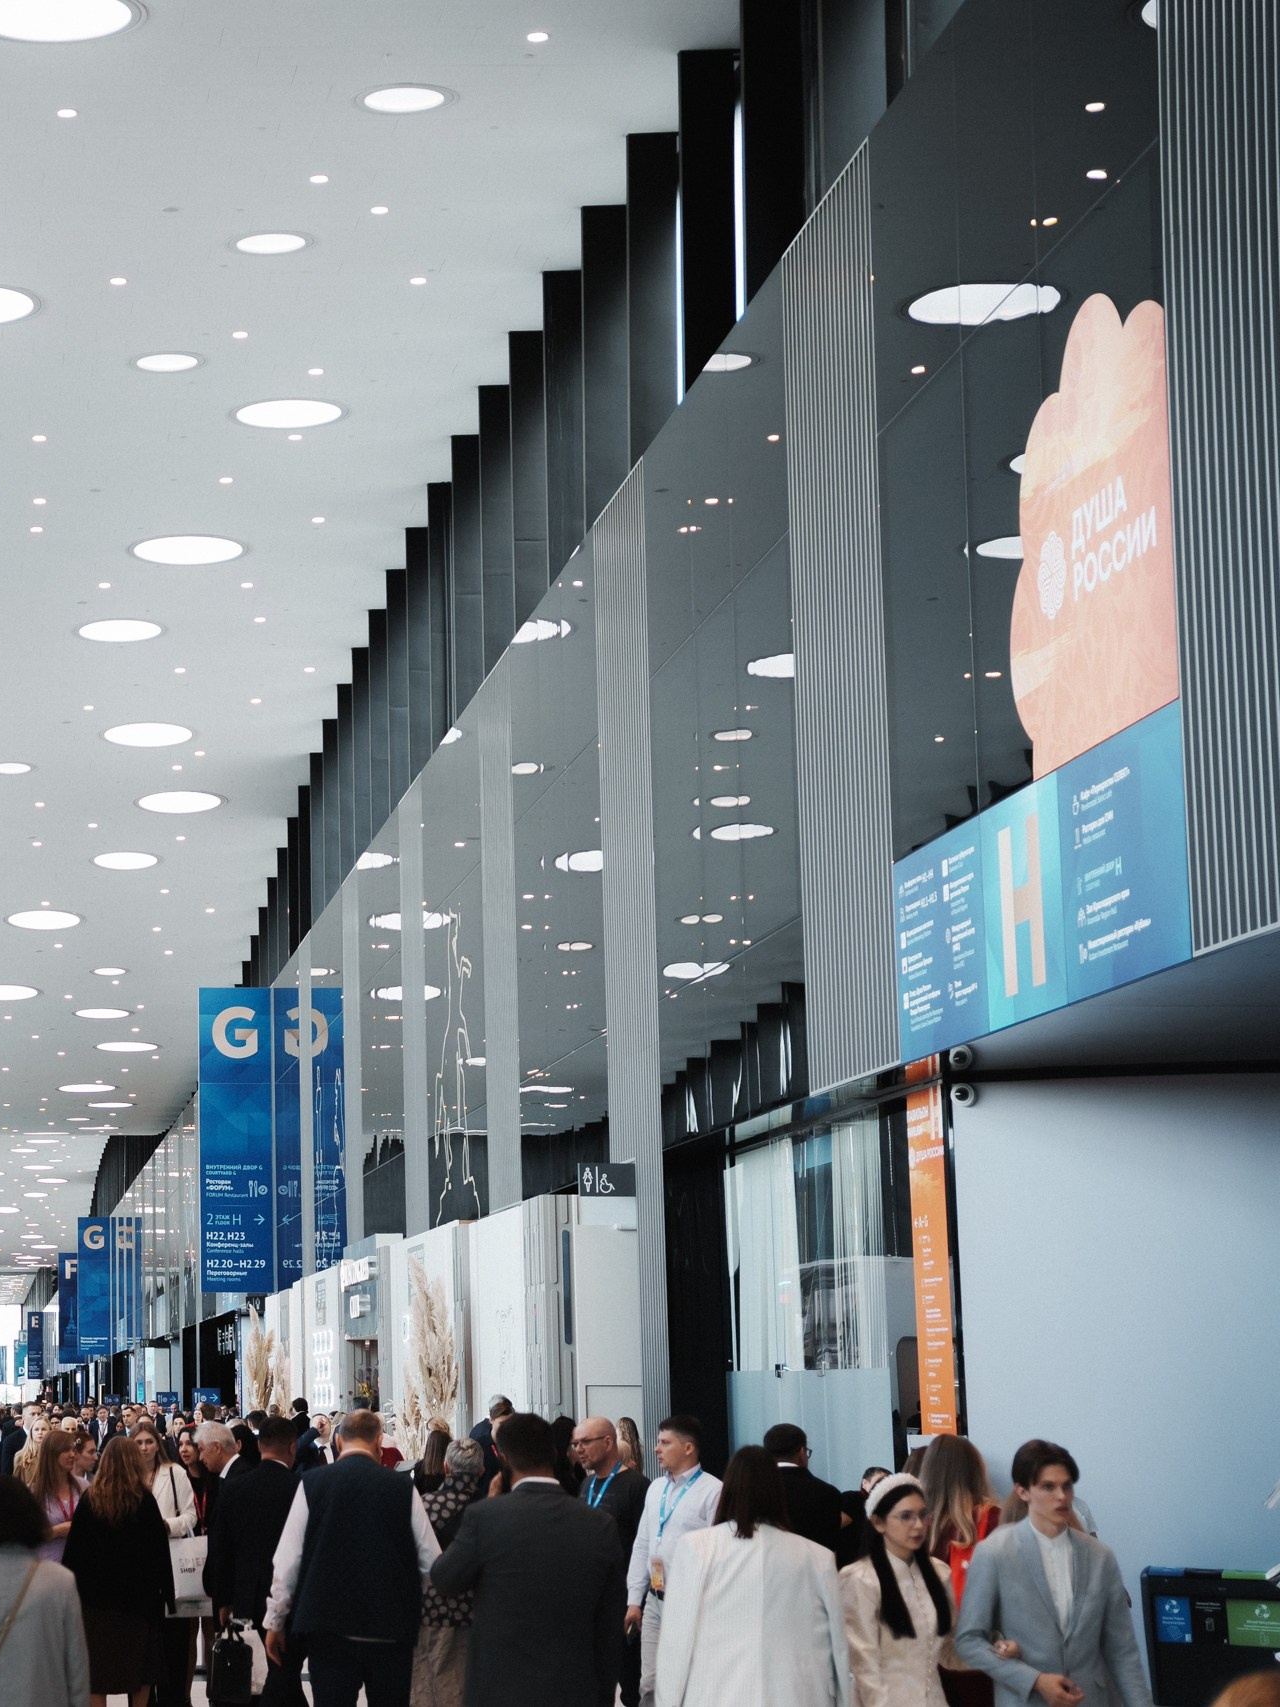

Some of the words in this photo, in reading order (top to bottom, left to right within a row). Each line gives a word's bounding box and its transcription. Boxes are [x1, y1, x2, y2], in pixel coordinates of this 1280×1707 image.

[1071, 475, 1127, 560] ДУША
[1073, 505, 1157, 601] РОССИИ
[998, 811, 1047, 998] H
[212, 1006, 258, 1059] G
[207, 1213, 213, 1225] 2
[233, 1214, 241, 1225] H
[83, 1225, 105, 1249] G
[65, 1260, 77, 1279] F
[31, 1315, 39, 1328] E
